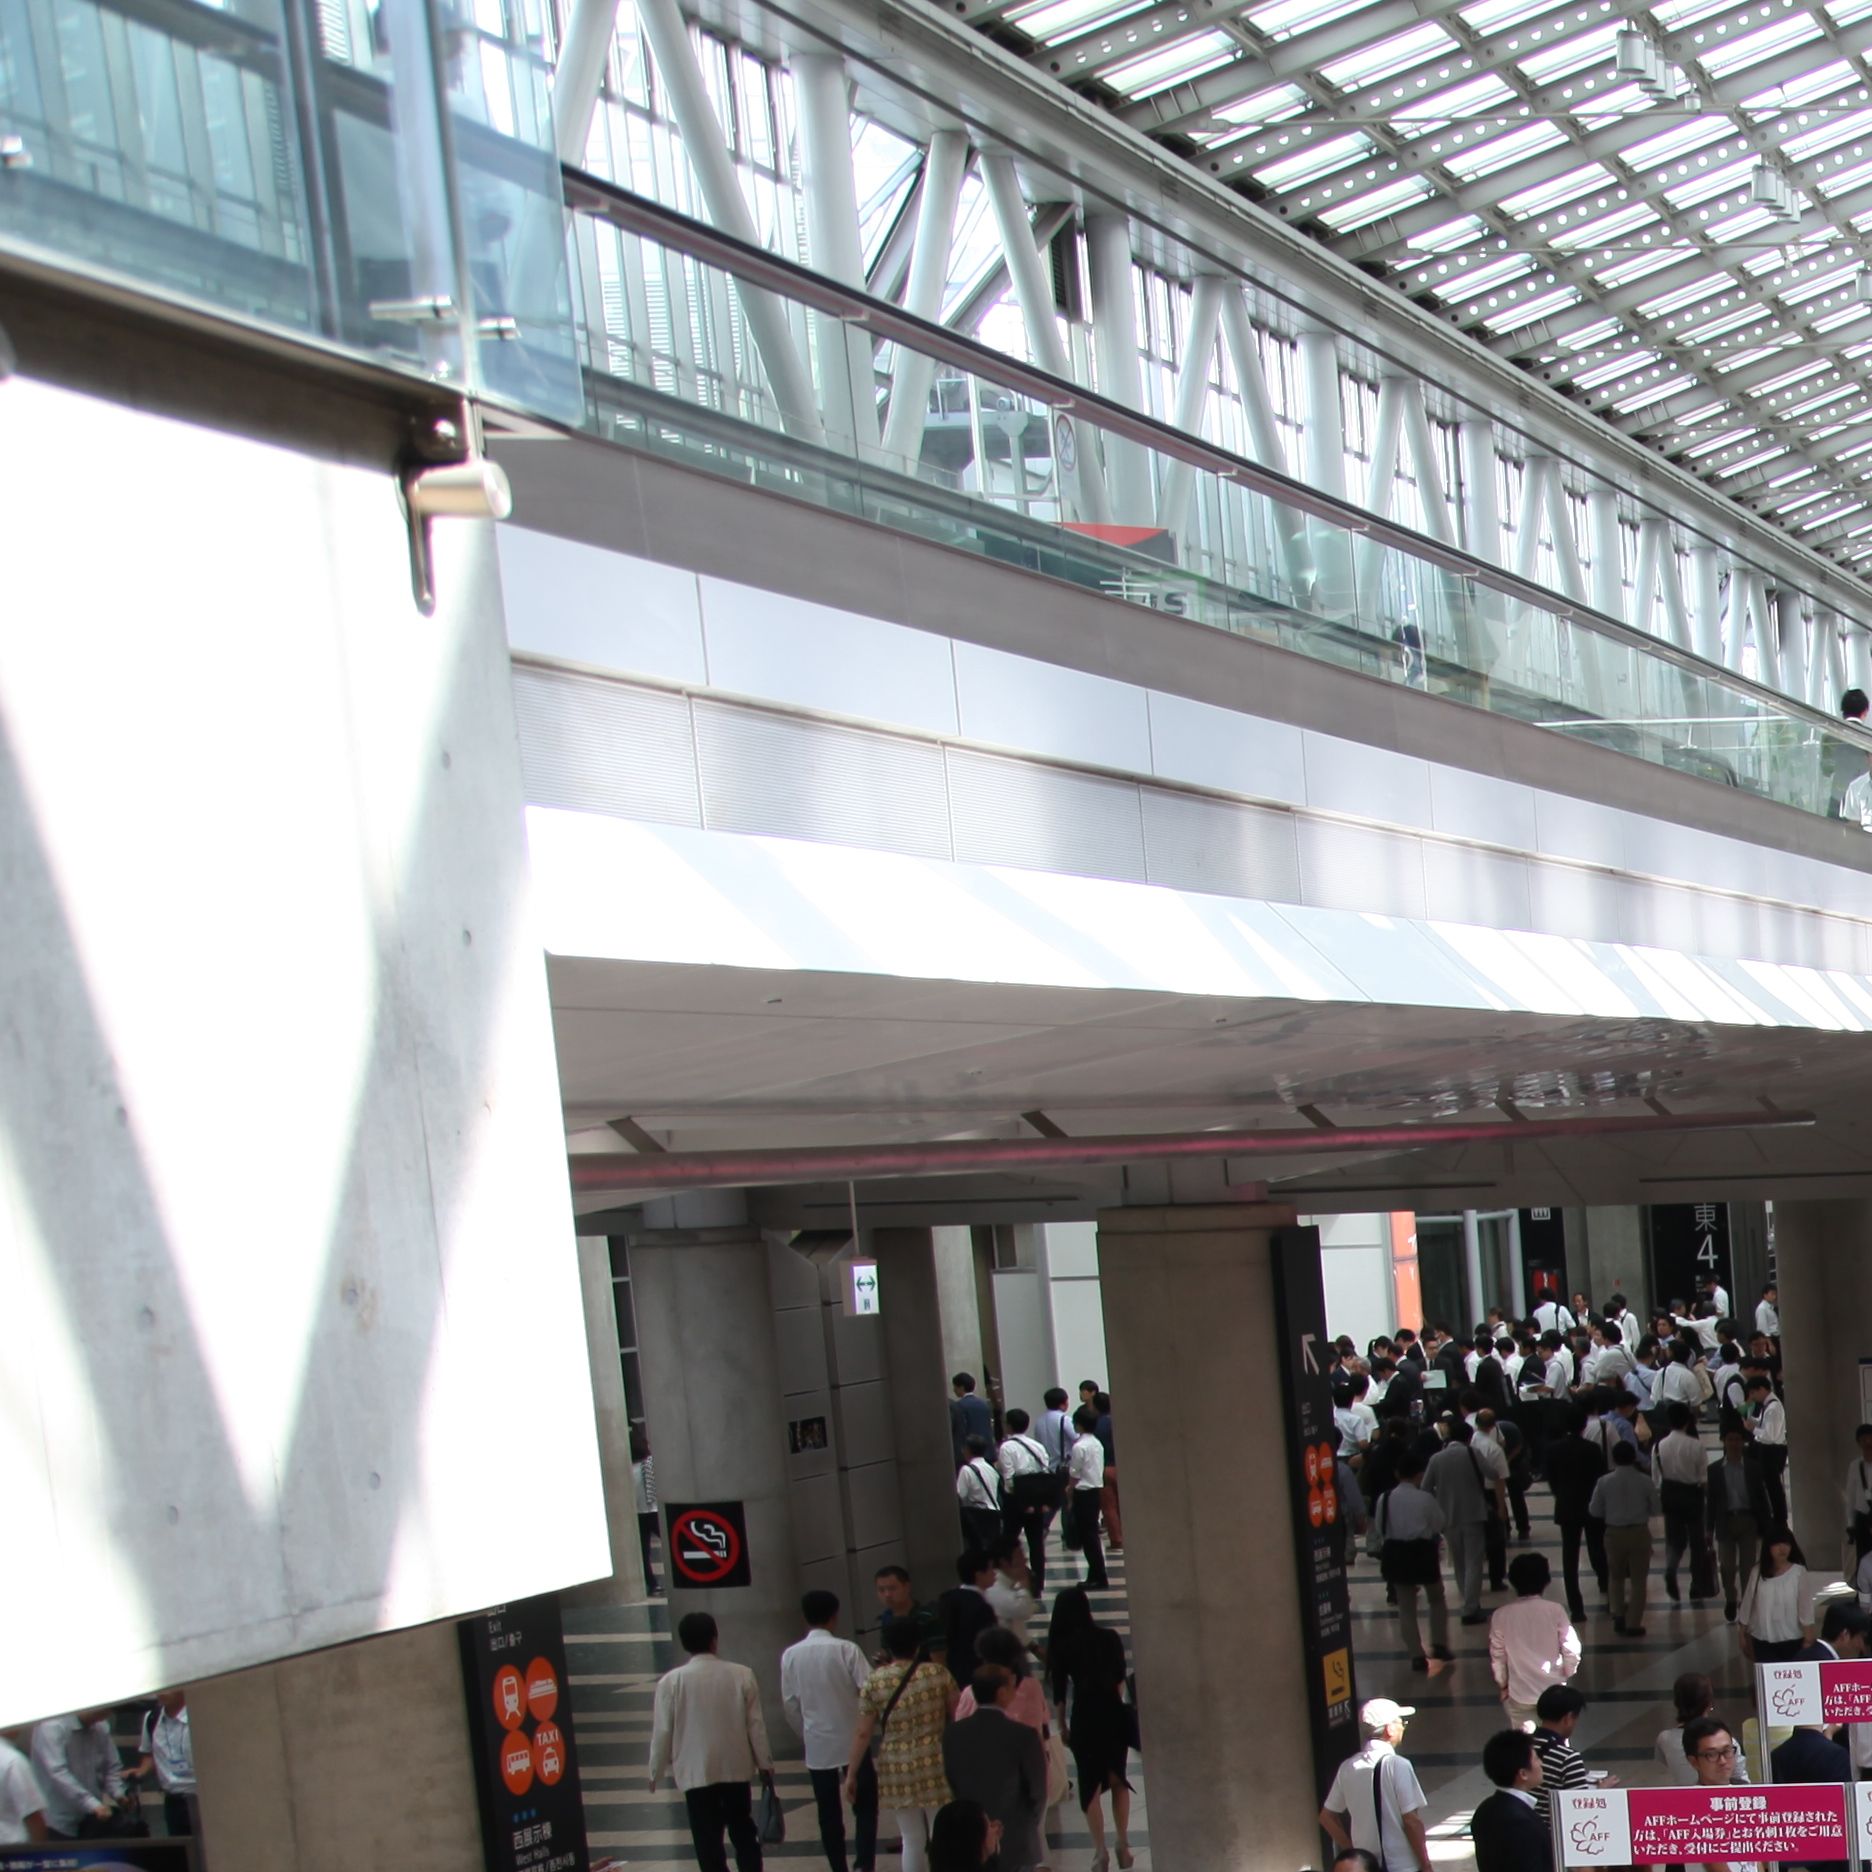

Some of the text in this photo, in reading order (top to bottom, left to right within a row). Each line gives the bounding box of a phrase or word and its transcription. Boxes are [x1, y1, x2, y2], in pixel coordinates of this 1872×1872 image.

[1693, 1203, 1716, 1231] 東
[1697, 1234, 1719, 1268] 4
[536, 1728, 559, 1746] TAXI
[1709, 1795, 1767, 1811] 事前登録
[513, 1821, 553, 1850] 西展示棟
